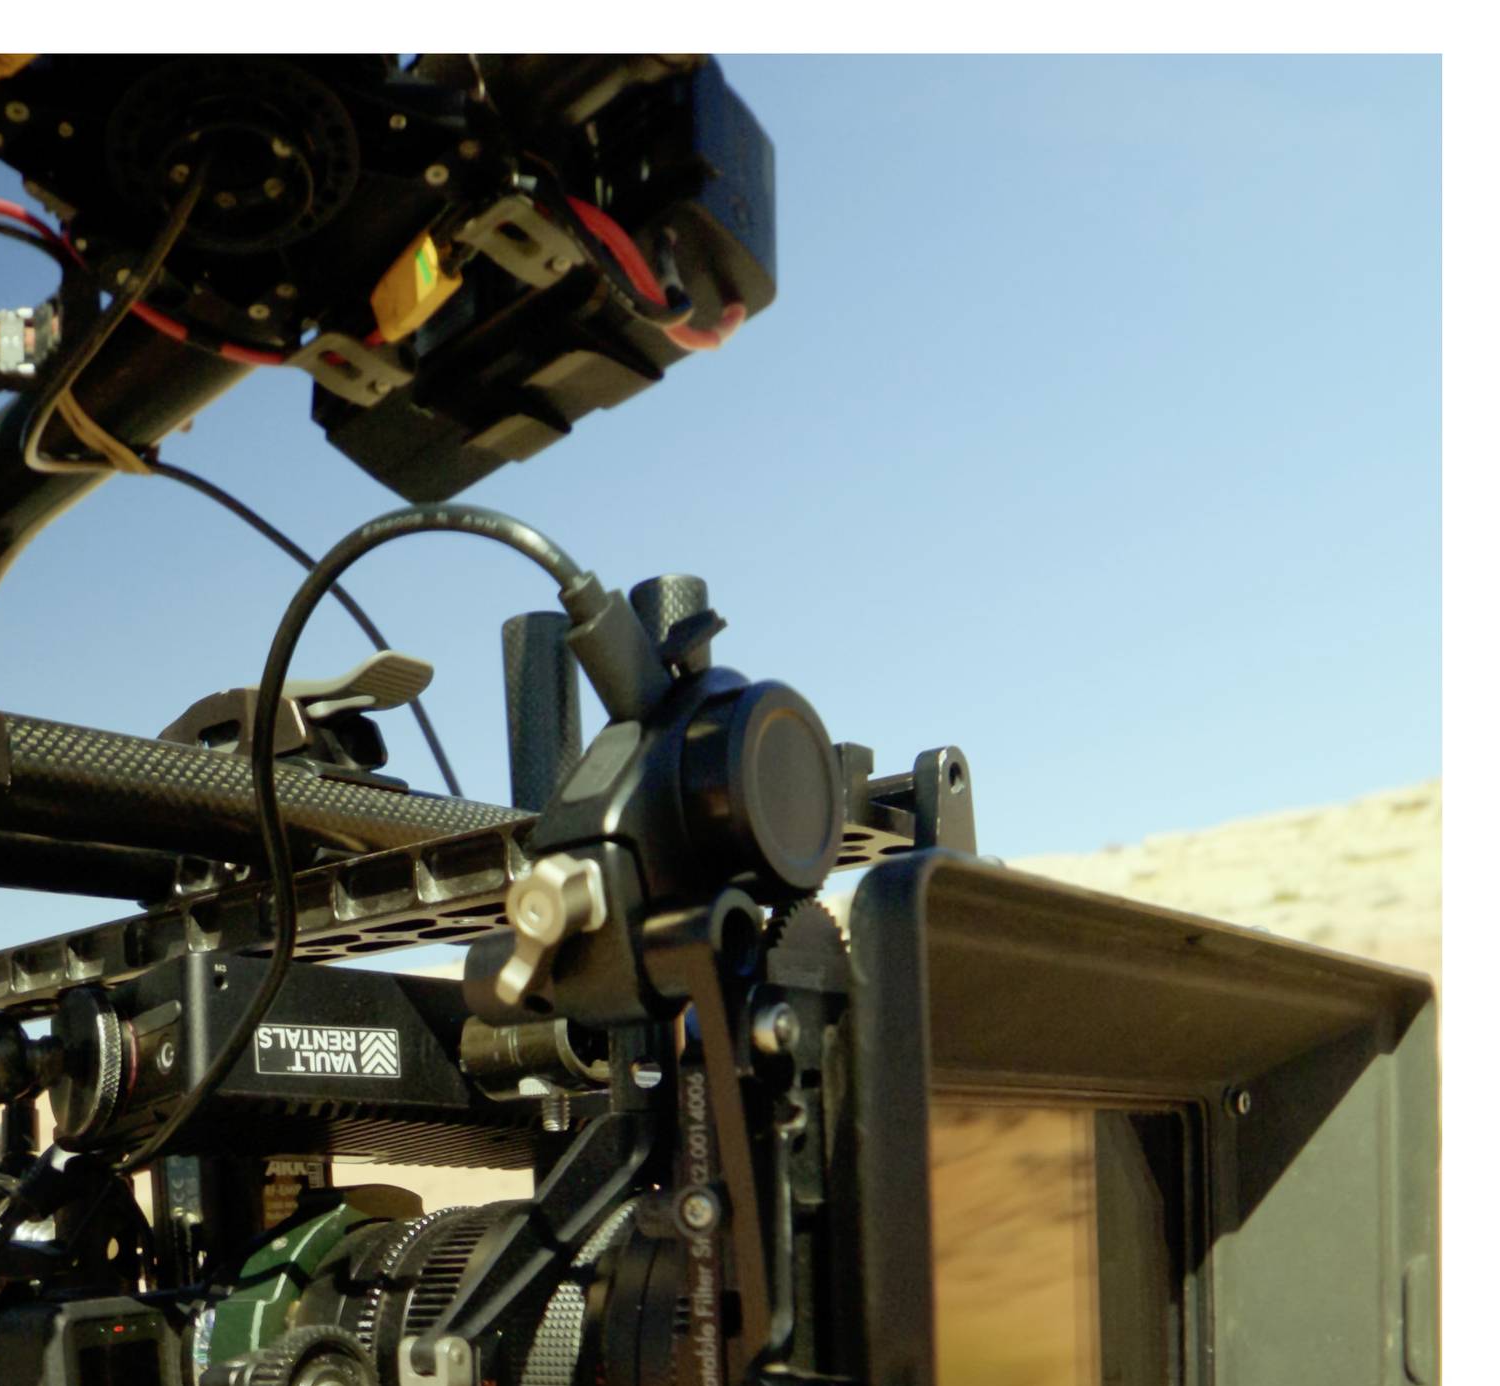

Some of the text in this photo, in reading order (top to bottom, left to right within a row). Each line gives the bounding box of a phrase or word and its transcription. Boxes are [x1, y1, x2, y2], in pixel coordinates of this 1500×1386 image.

[258, 1026, 357, 1052] RENTALS
[291, 1050, 358, 1074] VAULT
[691, 1263, 715, 1318] Filter
